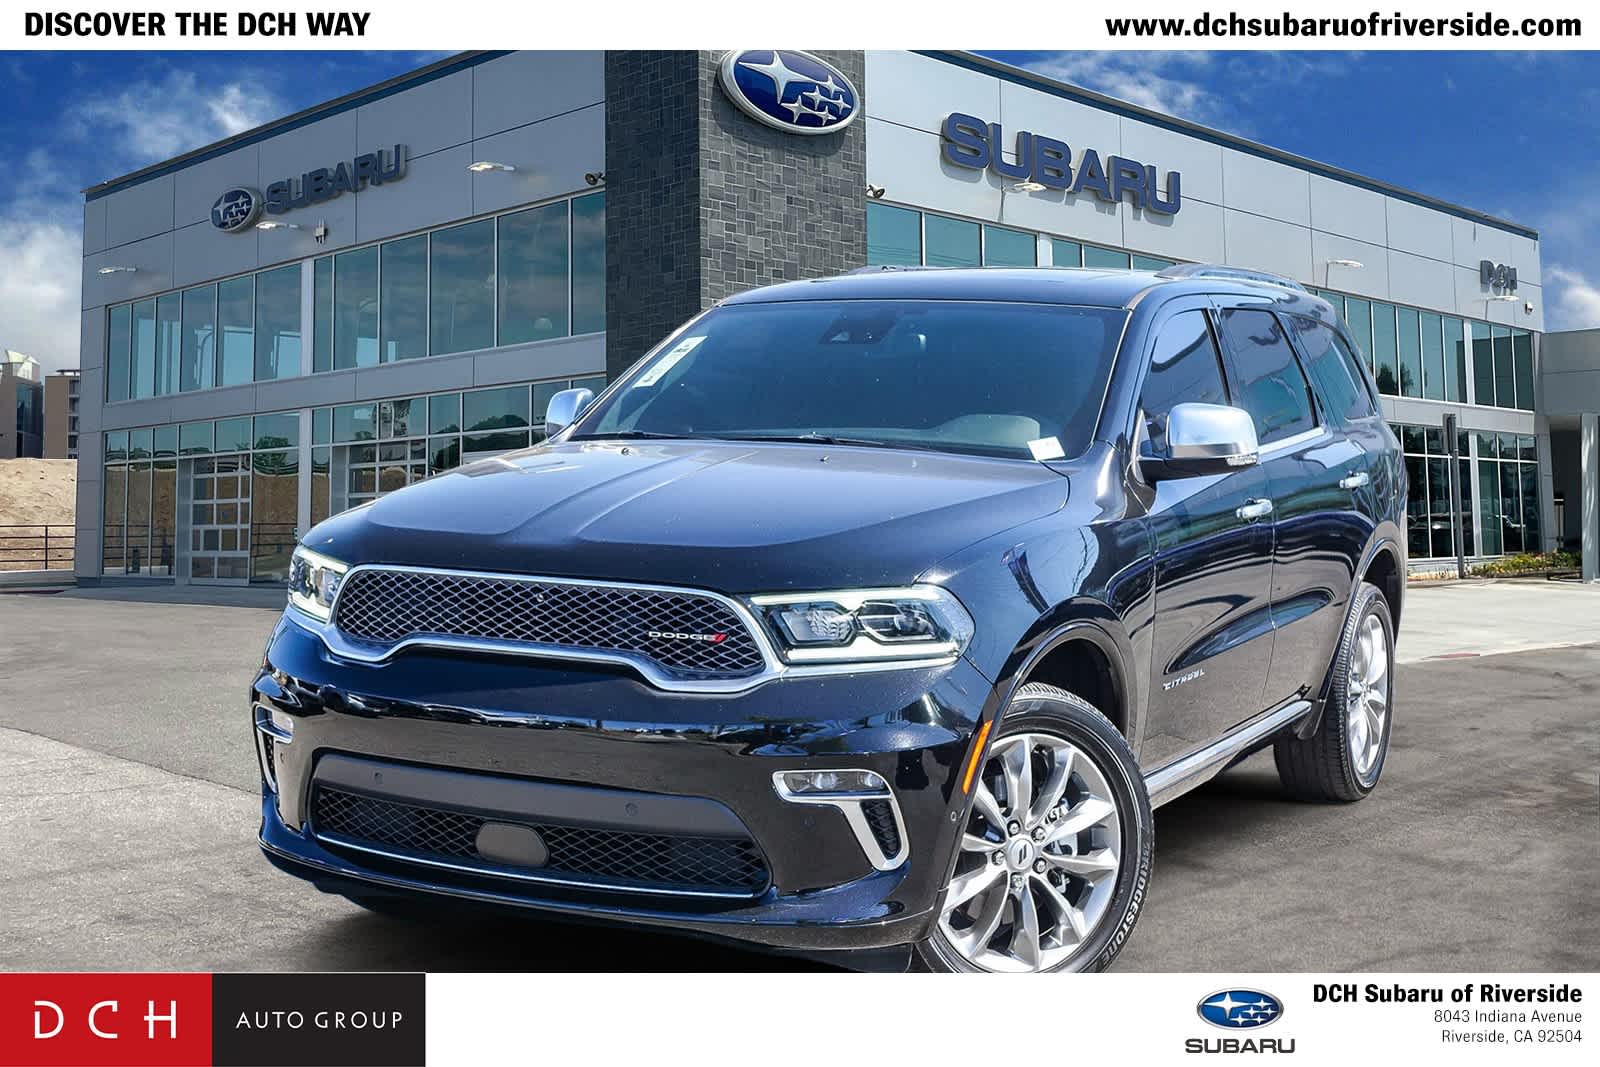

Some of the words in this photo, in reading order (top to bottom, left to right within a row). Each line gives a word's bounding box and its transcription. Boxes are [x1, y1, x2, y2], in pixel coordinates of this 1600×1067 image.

[266, 143, 407, 214] SUBARU
[940, 111, 1182, 215] SUBARU
[648, 630, 716, 642] DODGE
[1101, 848, 1150, 965] BRIDGESTONE
